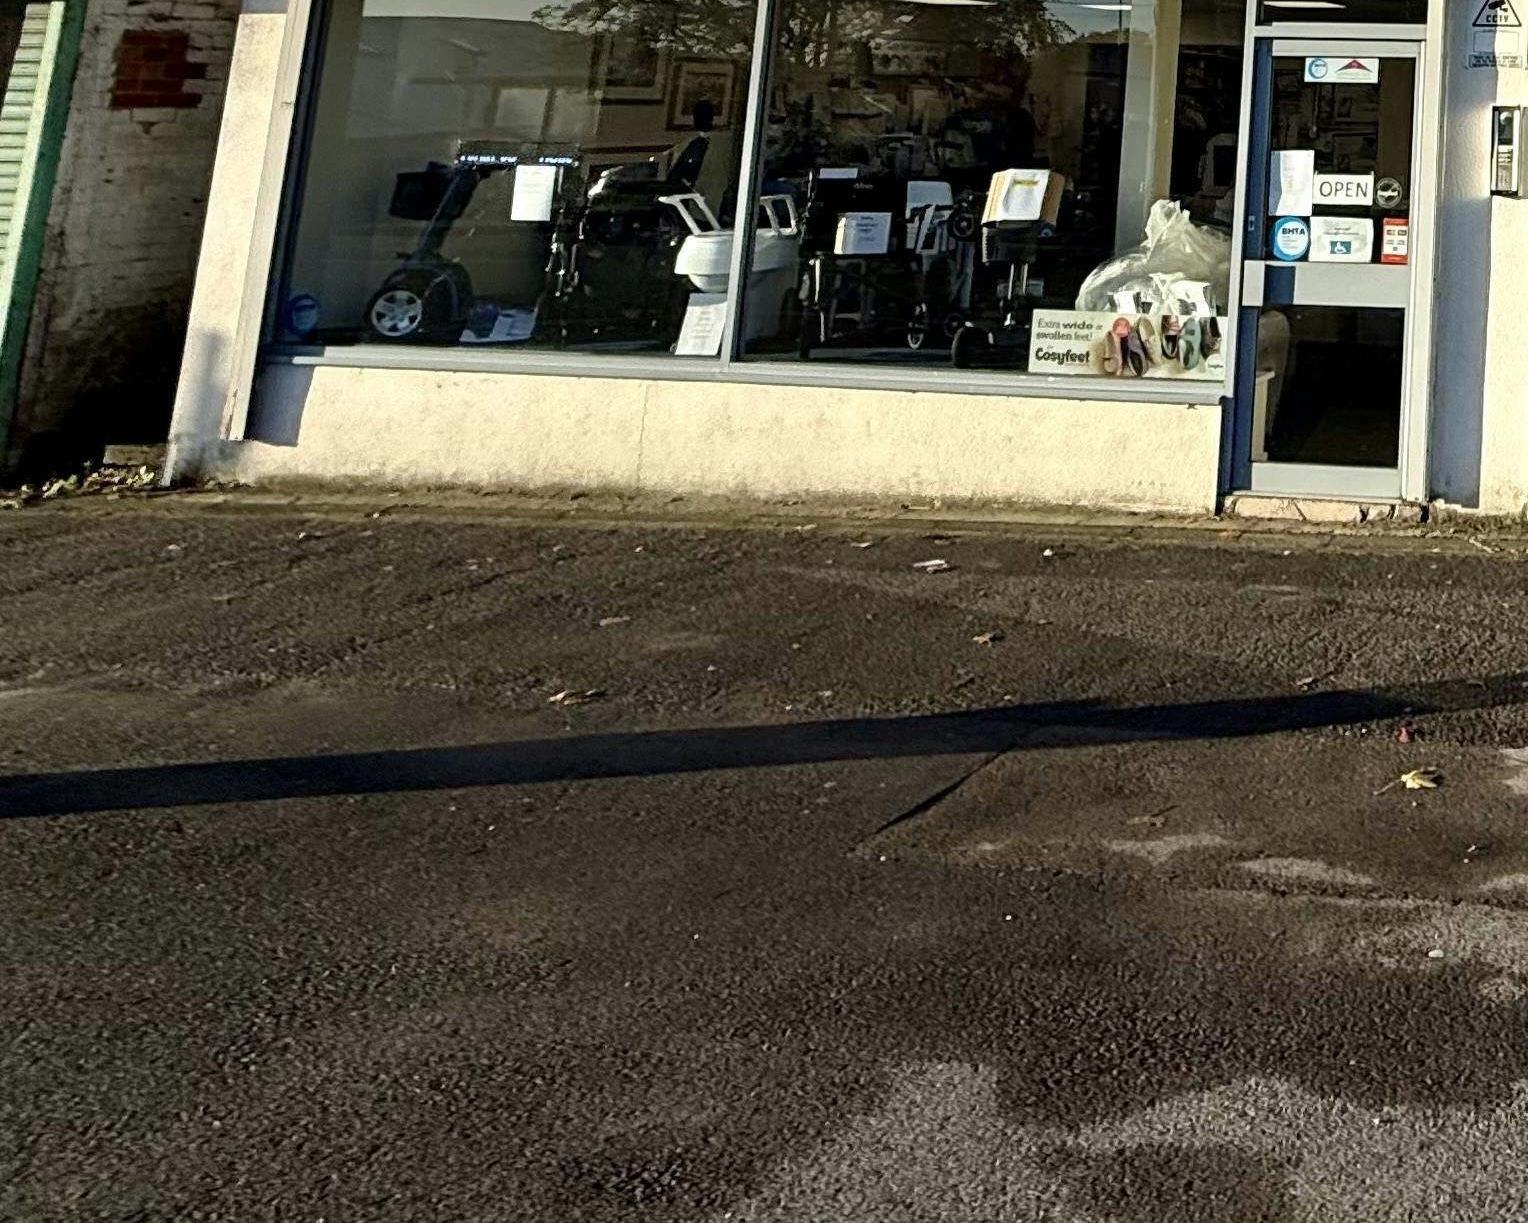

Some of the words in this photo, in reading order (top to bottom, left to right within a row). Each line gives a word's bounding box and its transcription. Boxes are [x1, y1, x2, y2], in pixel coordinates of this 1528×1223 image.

[1486, 15, 1509, 23] CCTV
[1319, 181, 1368, 198] OPEN
[1062, 320, 1093, 330] wide
[1035, 347, 1090, 365] Cosyfeet
